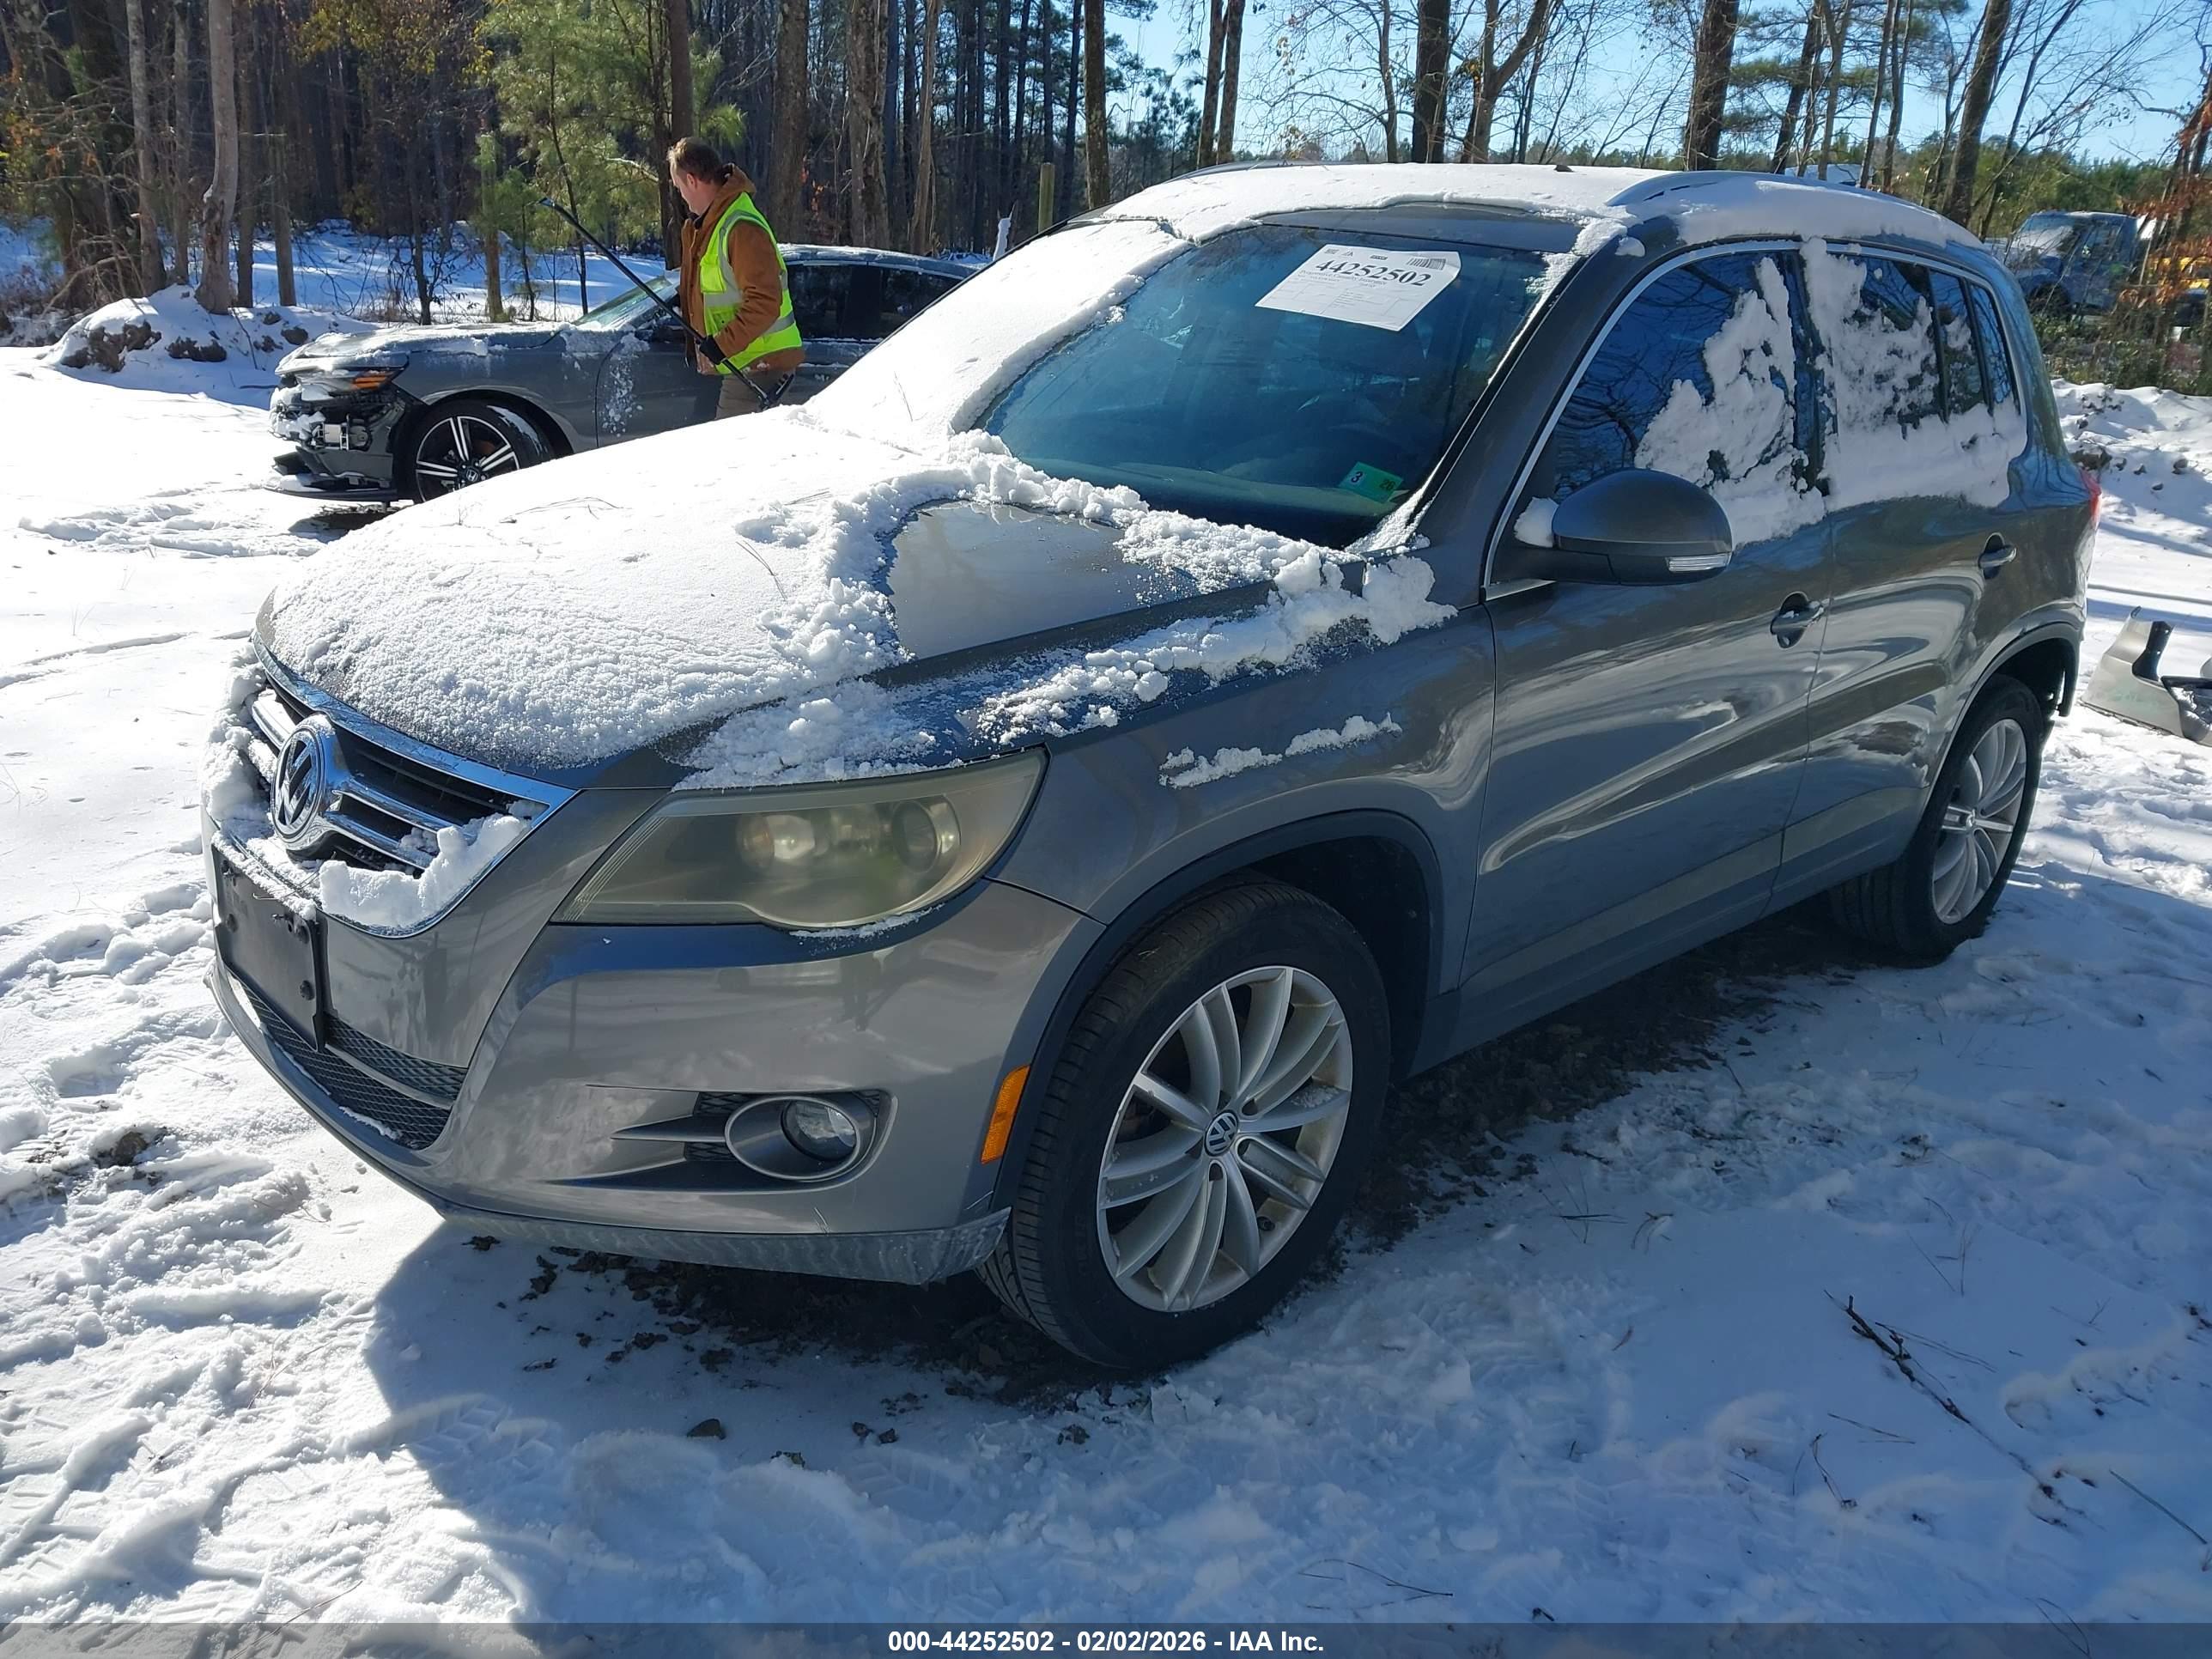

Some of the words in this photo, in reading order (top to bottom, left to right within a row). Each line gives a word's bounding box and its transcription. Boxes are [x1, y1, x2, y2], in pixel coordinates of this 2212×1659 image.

[1316, 259, 1431, 286] 44252502
[1351, 471, 1363, 483] 3
[1206, 1113, 1237, 1154] VW
